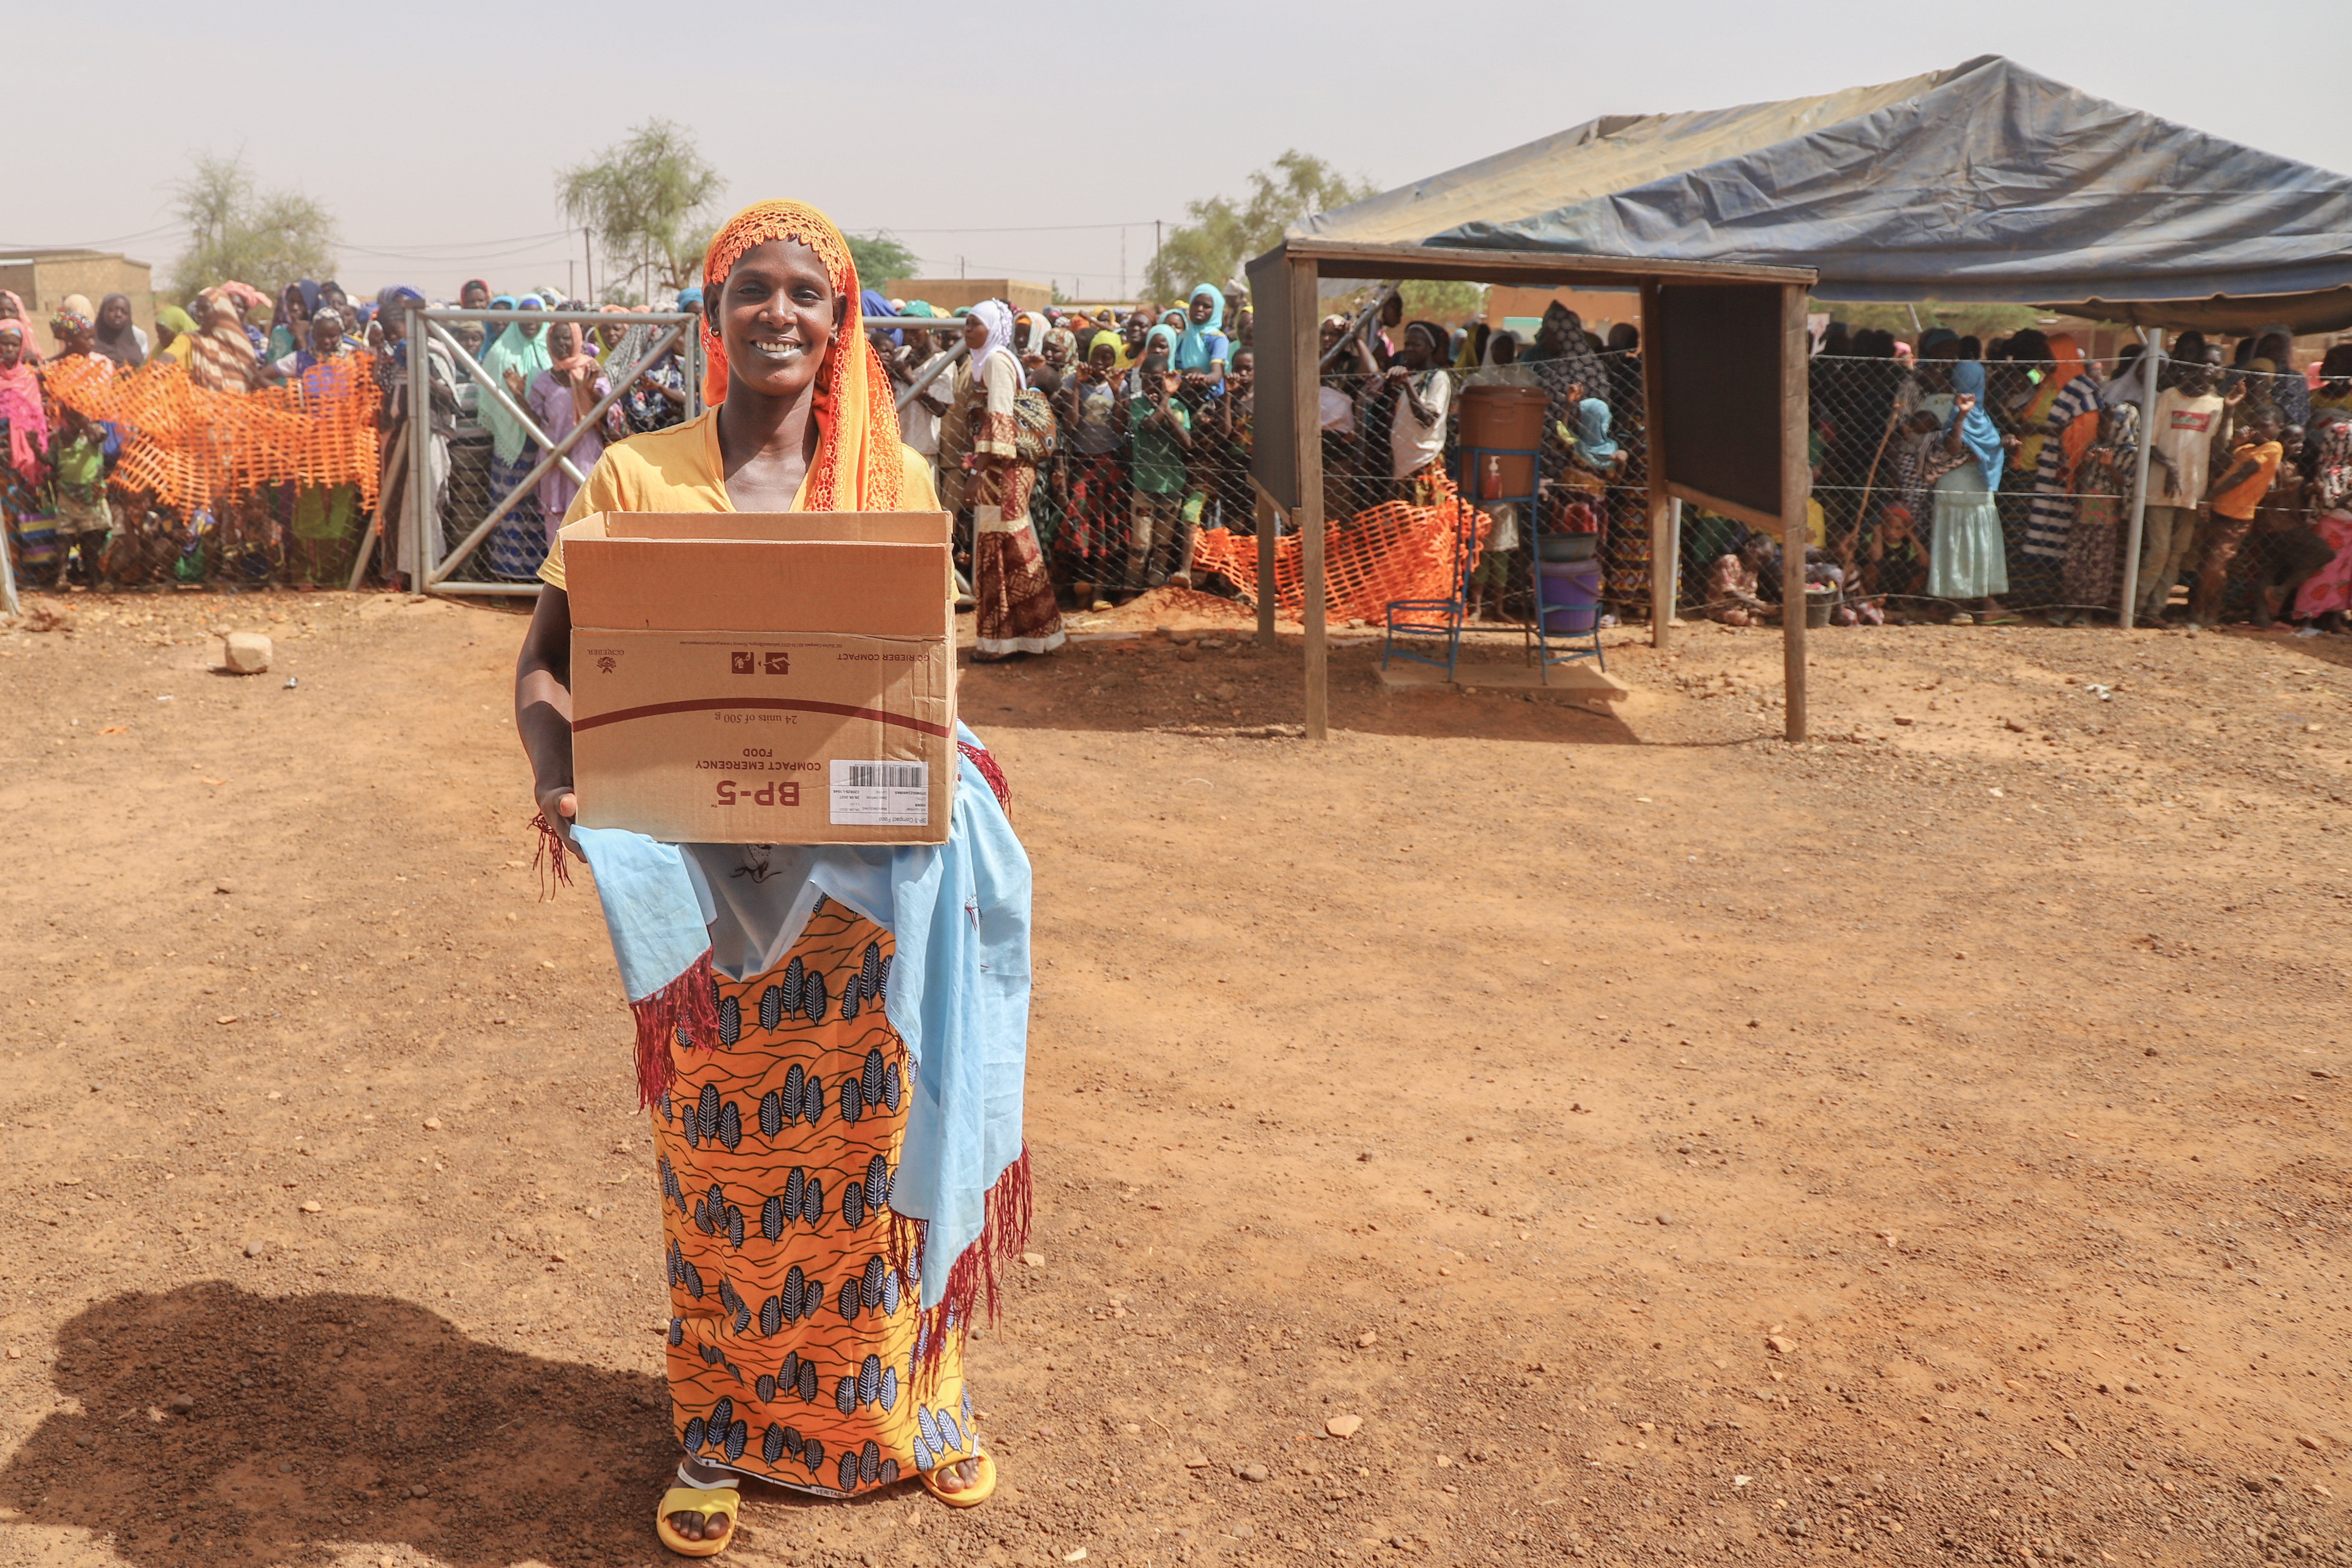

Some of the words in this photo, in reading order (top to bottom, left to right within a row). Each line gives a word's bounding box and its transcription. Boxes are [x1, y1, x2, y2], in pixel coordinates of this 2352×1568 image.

[724, 714, 742, 723] 500
[745, 714, 755, 723] of
[758, 715, 781, 723] units
[696, 761, 764, 770] EMERGENCY
[769, 762, 821, 771] COMPACT
[815, 1488, 850, 1498] VERITABLE
